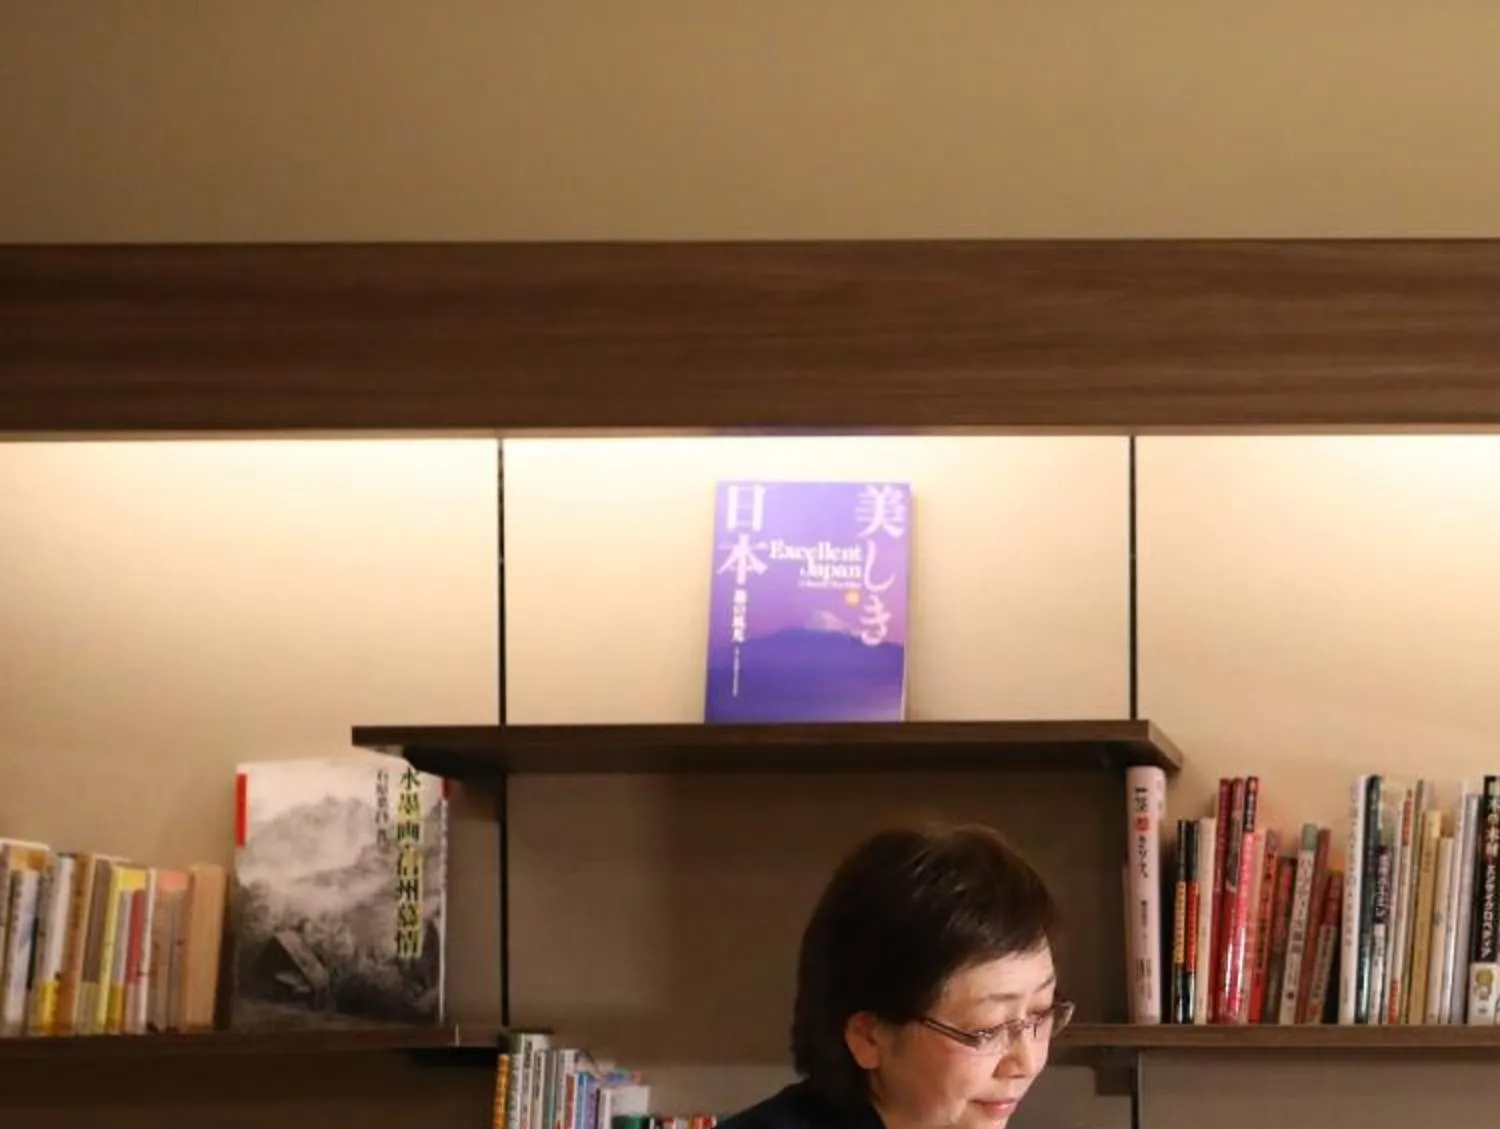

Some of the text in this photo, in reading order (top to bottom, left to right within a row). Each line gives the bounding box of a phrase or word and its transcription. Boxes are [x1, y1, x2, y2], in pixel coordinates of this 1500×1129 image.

[716, 484, 768, 586] 日本
[769, 538, 862, 562] Excellent
[856, 484, 905, 646] 美しき
[800, 558, 862, 580] Japan
